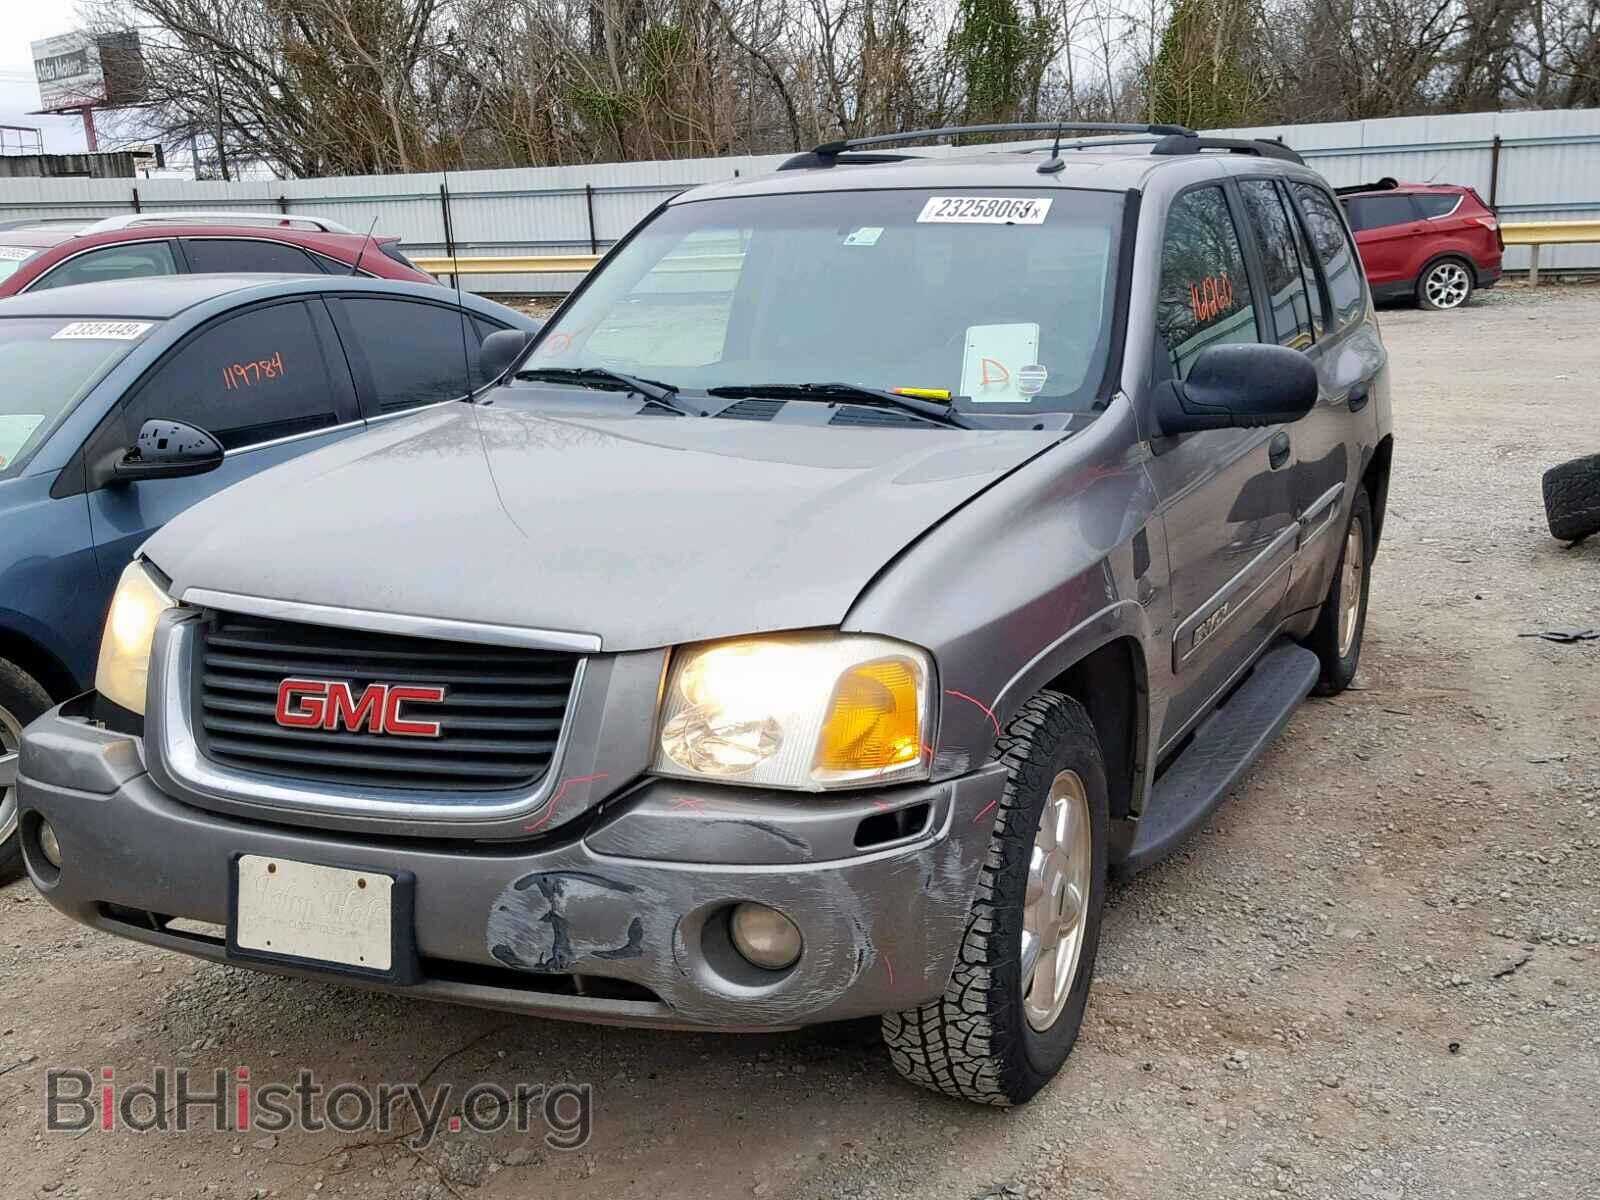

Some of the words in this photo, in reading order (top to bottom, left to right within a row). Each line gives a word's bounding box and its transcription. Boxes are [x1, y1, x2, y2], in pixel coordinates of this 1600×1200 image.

[222, 351, 284, 391] 119784
[981, 358, 1010, 385] D
[275, 678, 445, 737] GMC
